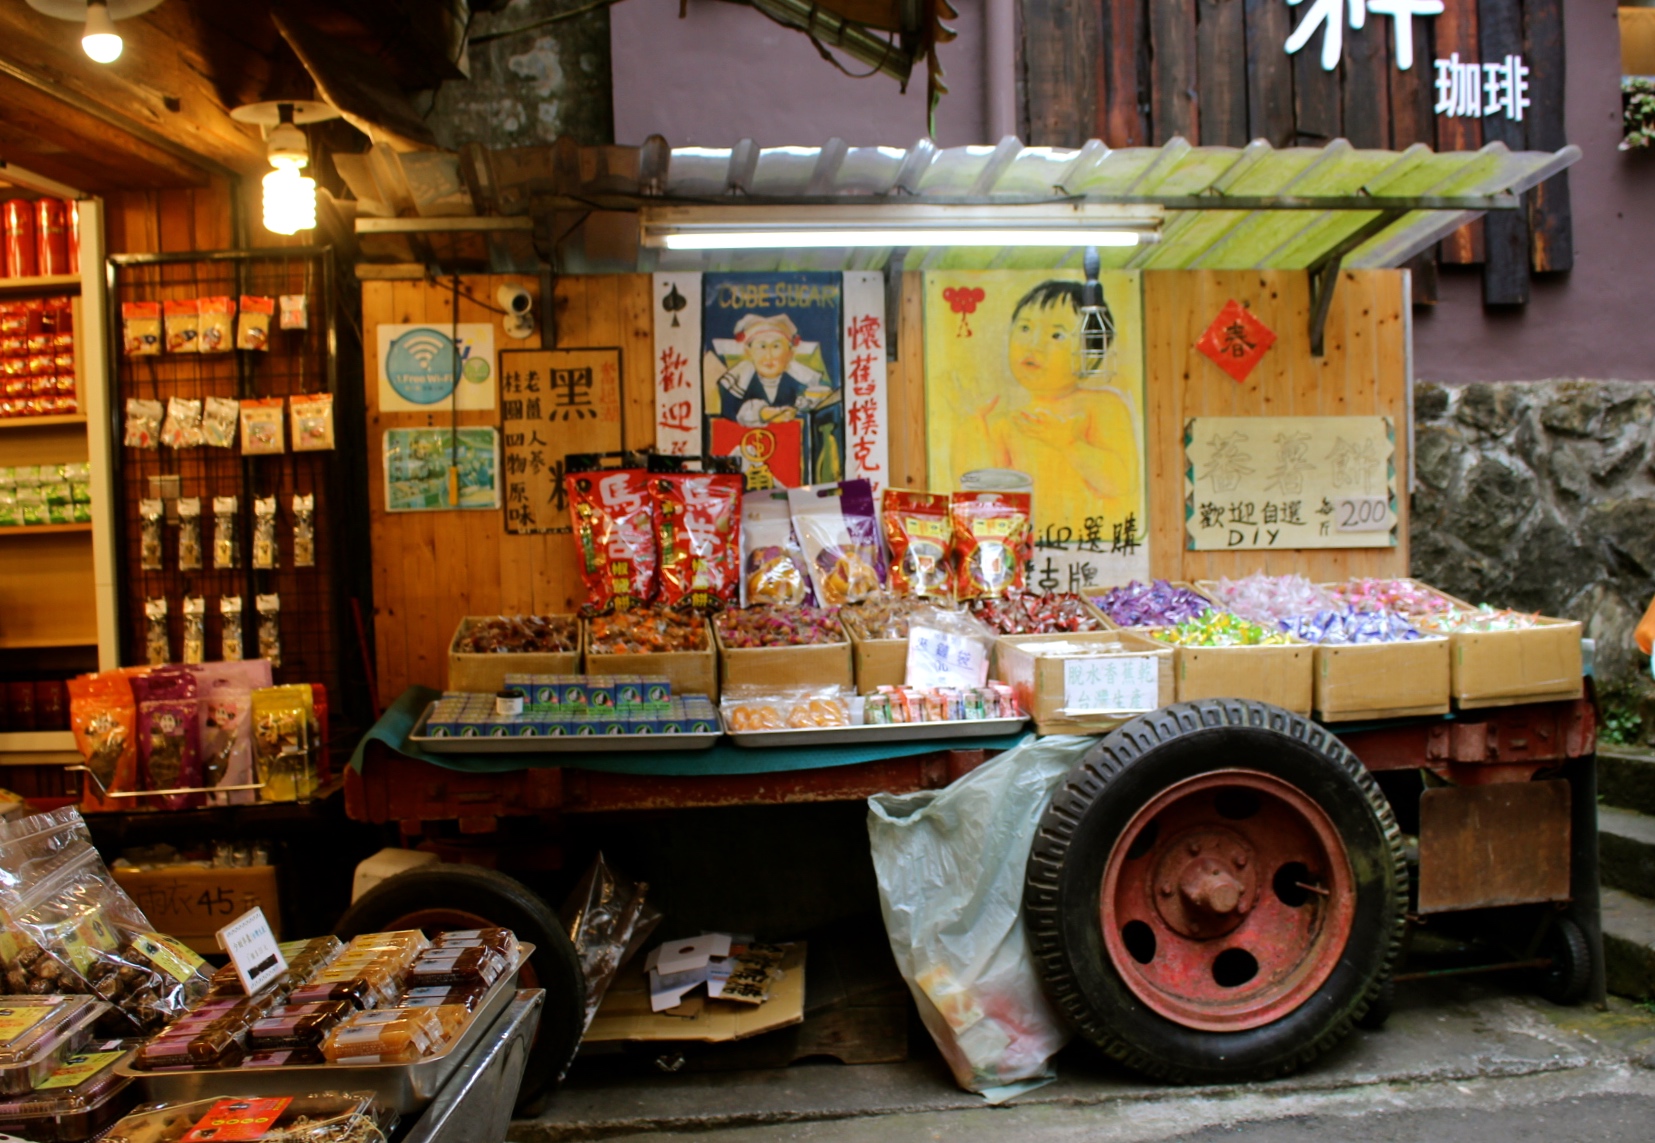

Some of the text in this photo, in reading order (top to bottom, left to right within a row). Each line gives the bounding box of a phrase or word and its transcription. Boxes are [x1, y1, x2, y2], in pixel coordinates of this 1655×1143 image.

[1434, 52, 1530, 121] 珈琲
[718, 281, 839, 309] CUBE SUGAR
[1220, 321, 1257, 358] 春
[1200, 501, 1308, 528] 歡迎自選
[1341, 499, 1388, 527] 200
[1227, 528, 1280, 547] DIY
